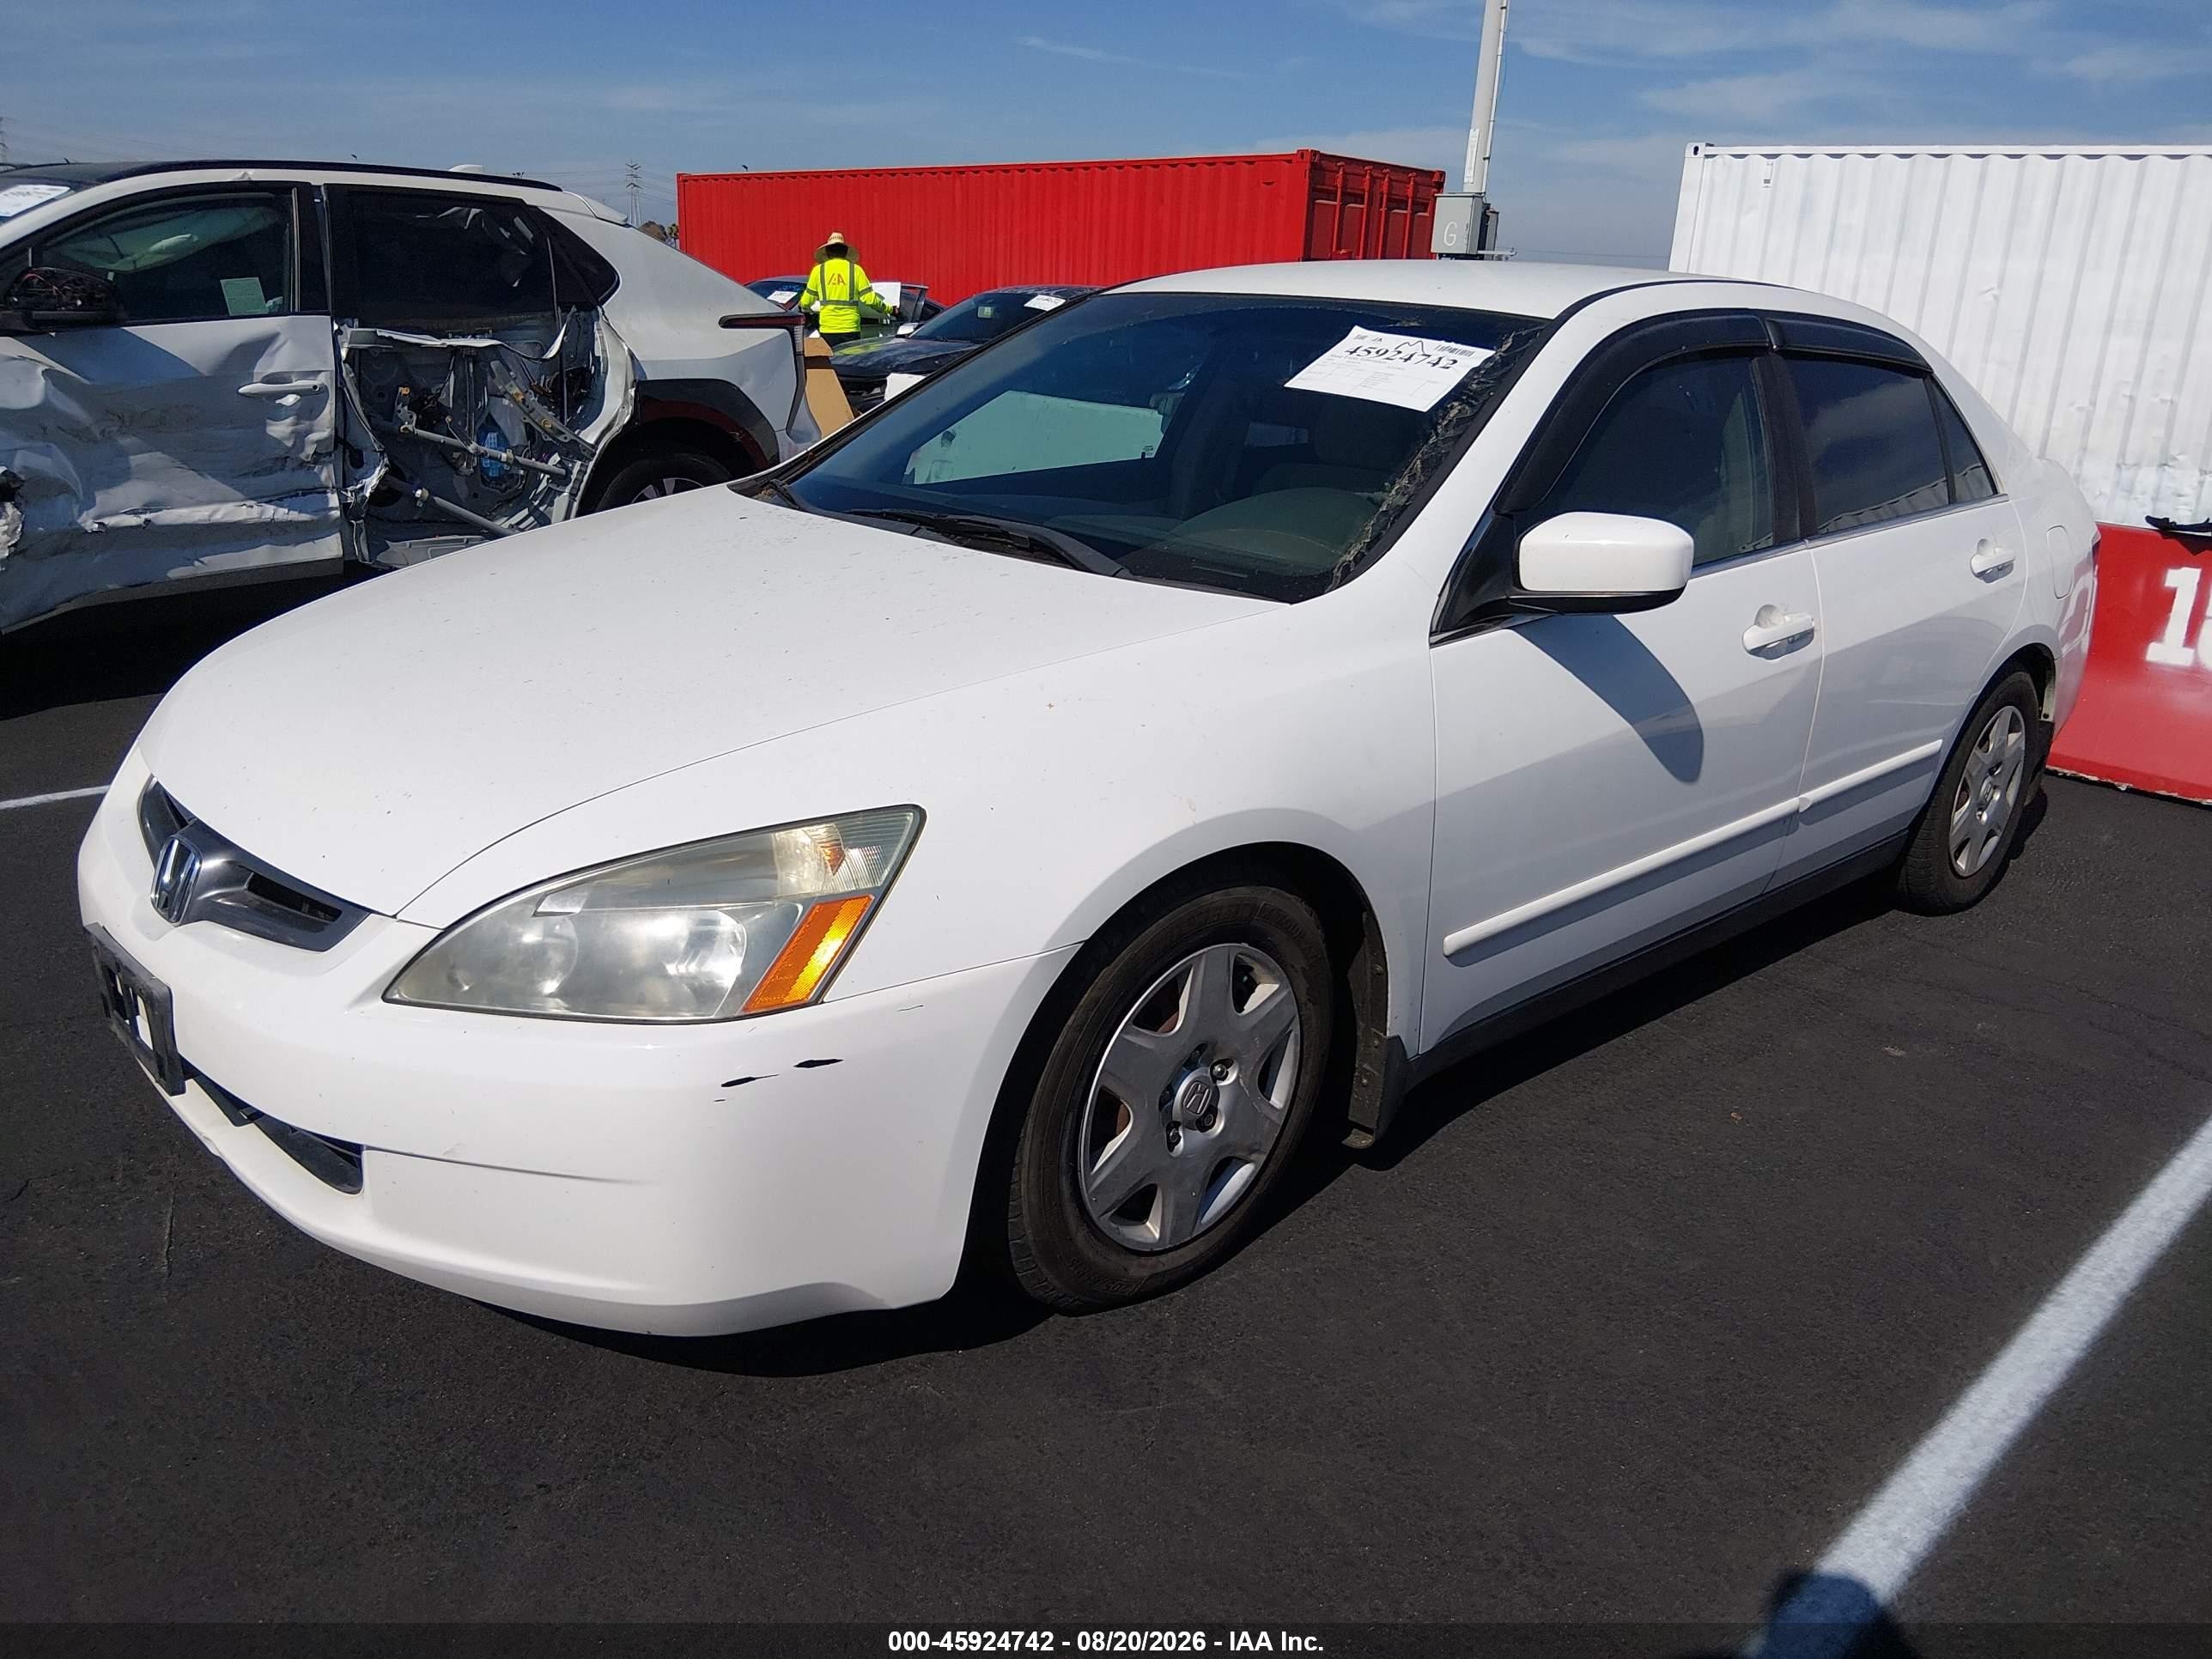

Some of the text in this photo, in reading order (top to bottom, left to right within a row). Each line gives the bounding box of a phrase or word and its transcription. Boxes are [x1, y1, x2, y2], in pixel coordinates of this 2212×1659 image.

[1443, 222, 1457, 246] G
[1345, 345, 1458, 369] 45924742
[2146, 567, 2212, 668] 1
